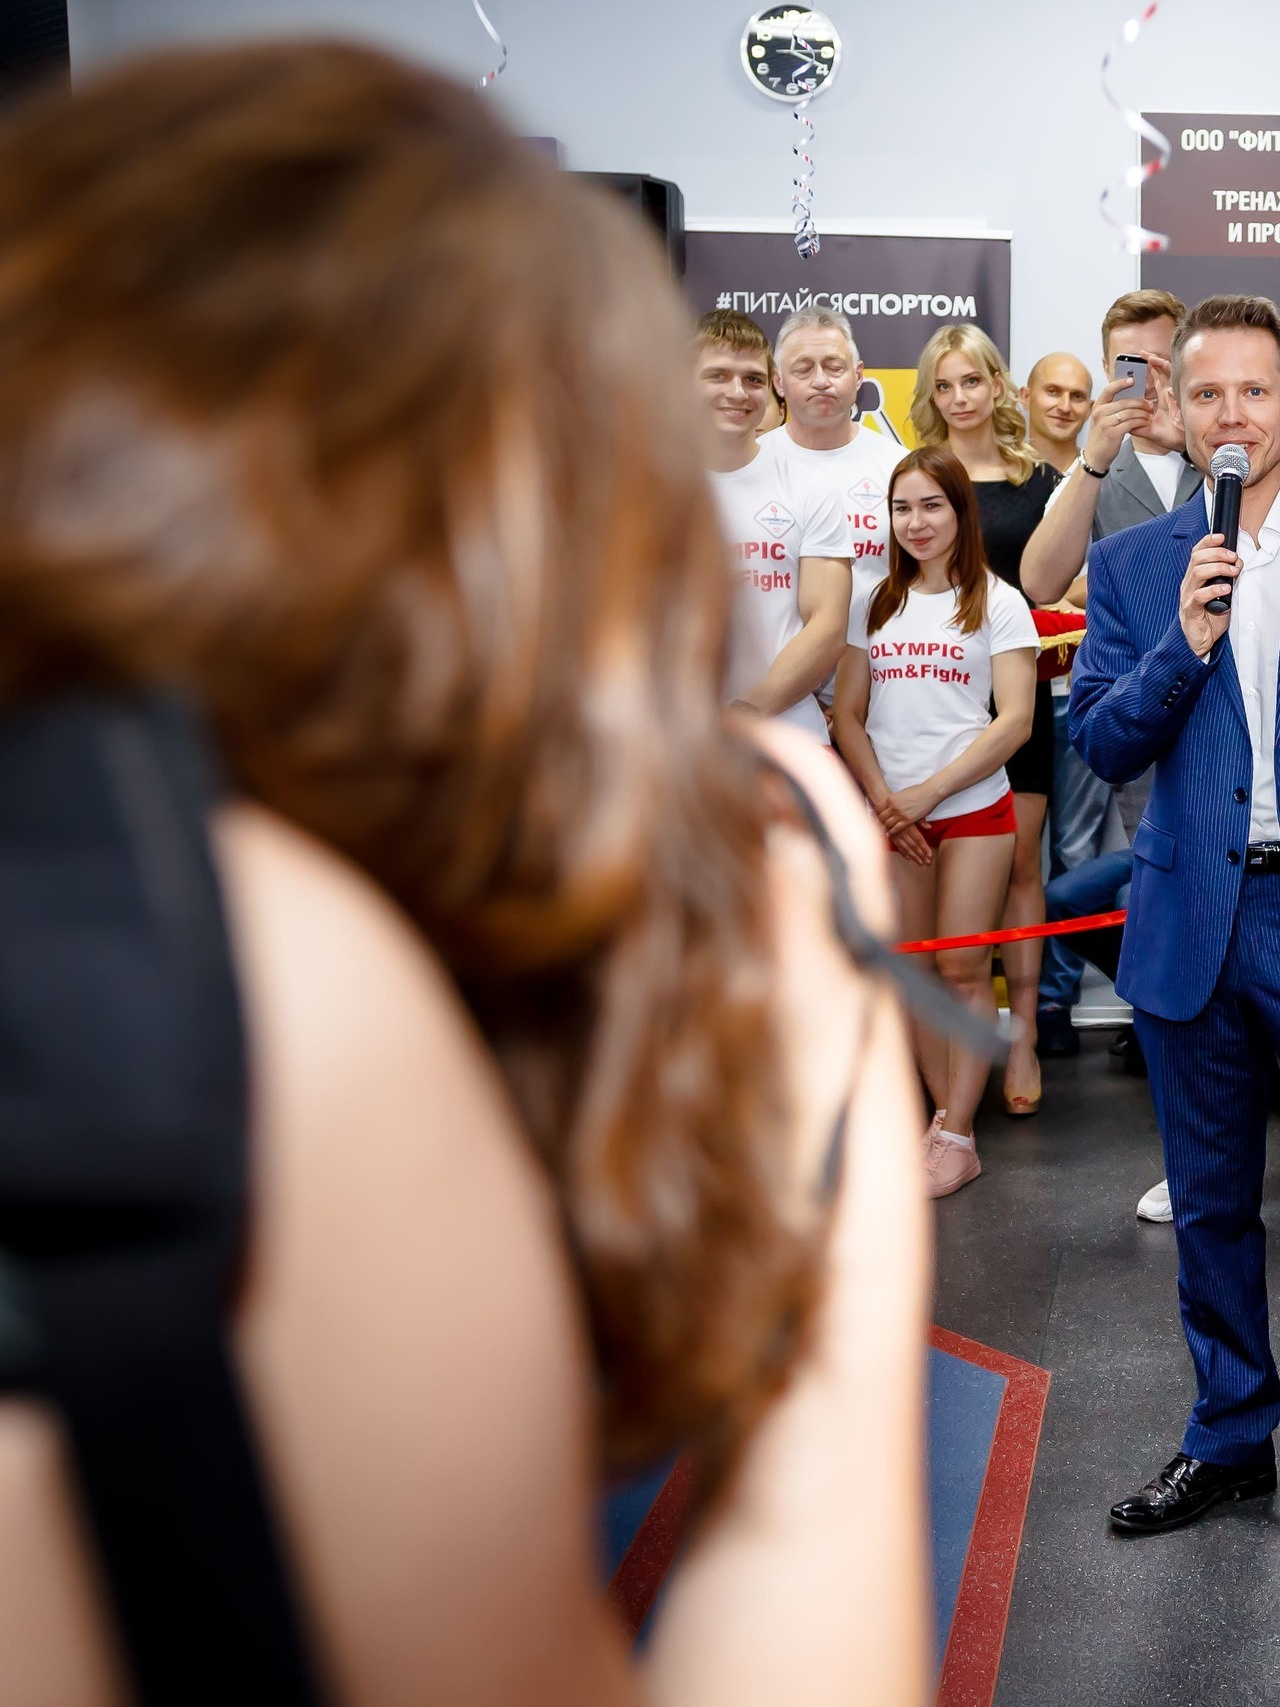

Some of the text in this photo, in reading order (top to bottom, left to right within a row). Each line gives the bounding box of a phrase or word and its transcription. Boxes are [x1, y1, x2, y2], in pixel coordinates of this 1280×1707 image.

[1181, 129, 1224, 152] ООО
[1228, 223, 1243, 243] И
[847, 514, 878, 530] IC
[870, 642, 965, 661] OLYMPIC
[872, 664, 971, 685] Gym&Fight
